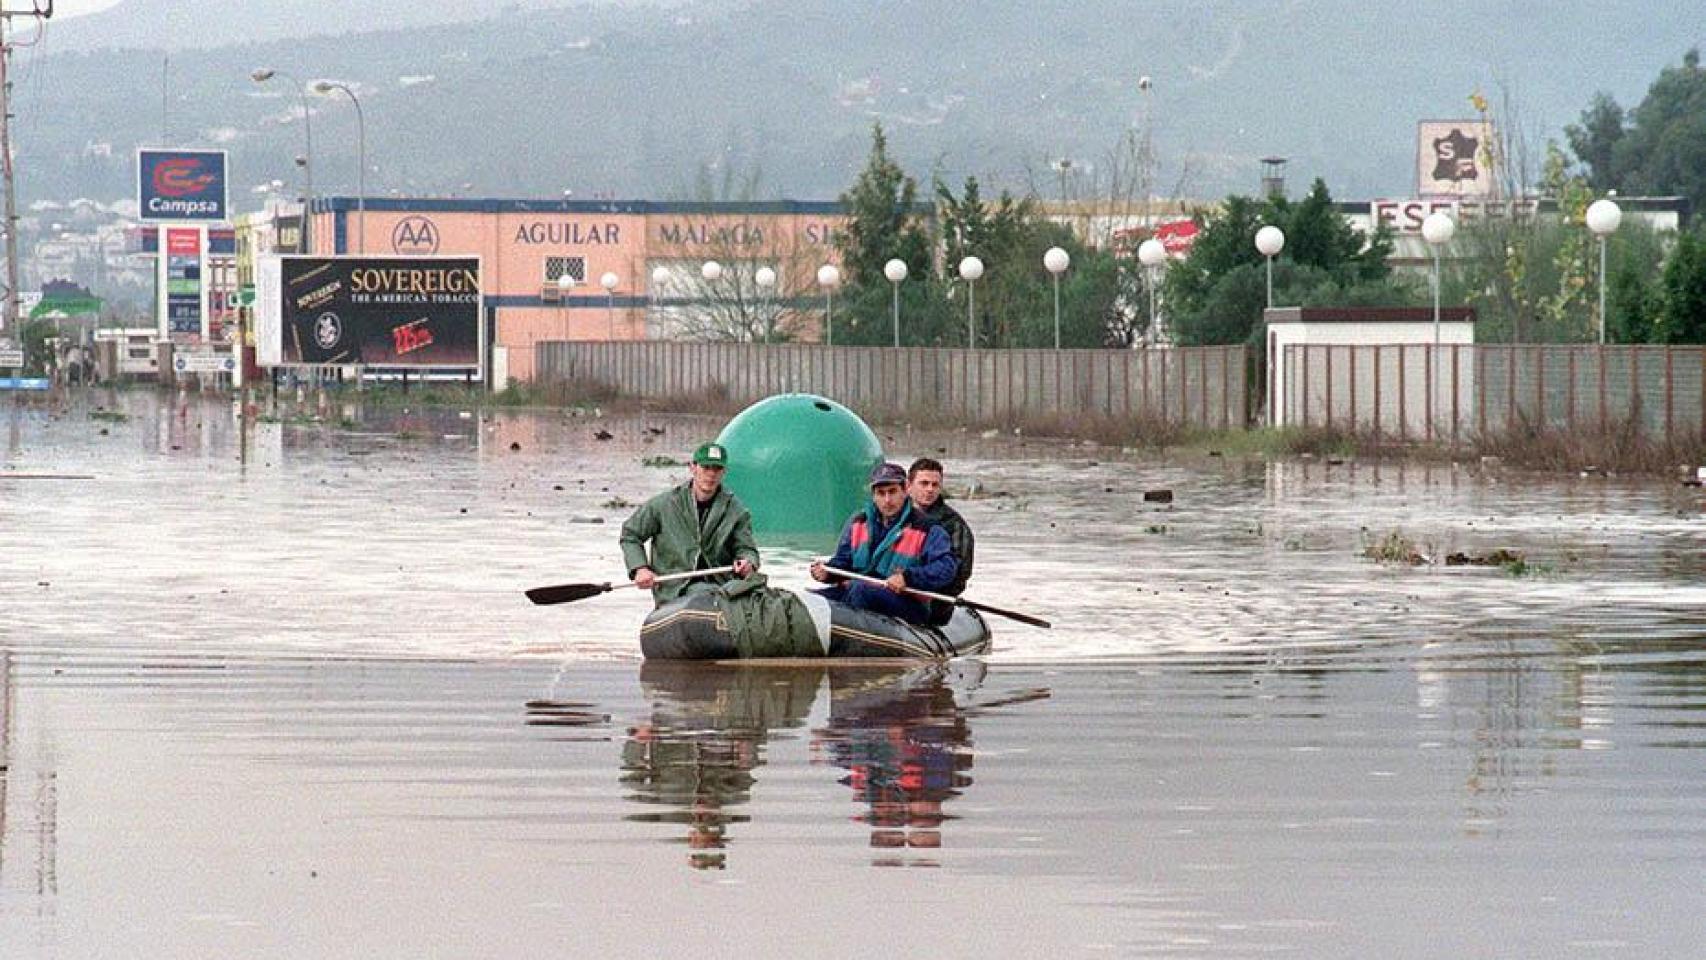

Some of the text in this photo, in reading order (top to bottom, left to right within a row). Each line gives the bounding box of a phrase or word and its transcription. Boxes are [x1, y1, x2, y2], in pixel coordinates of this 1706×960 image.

[148, 197, 218, 215] Campsa
[515, 222, 620, 245] AGUILAR
[350, 269, 479, 293] SOVEREIGN
[351, 294, 479, 303] THE AMERICAN TOBACCO
